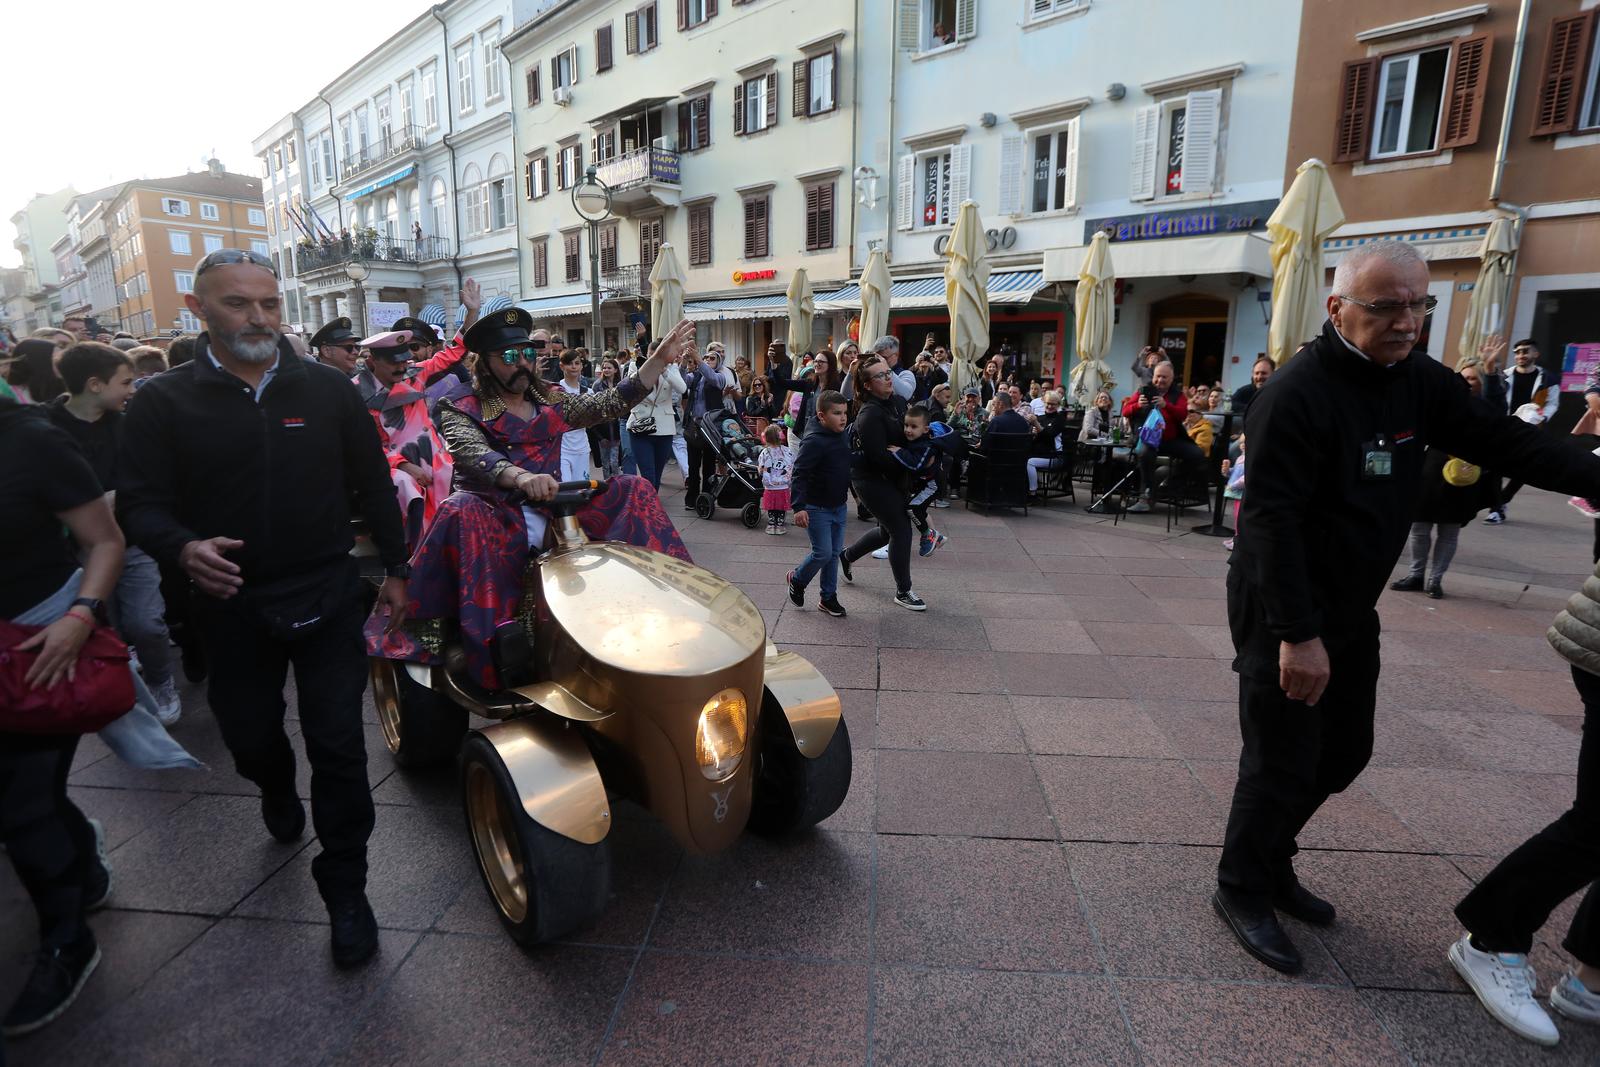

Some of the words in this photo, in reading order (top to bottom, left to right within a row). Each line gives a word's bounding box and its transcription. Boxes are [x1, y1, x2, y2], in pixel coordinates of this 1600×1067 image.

[1170, 115, 1186, 166] Swiss
[653, 154, 678, 165] HAPPY
[653, 163, 680, 174] HOSTEL
[926, 162, 938, 203] Swiss
[1101, 211, 1216, 240] Gentleman
[1226, 214, 1259, 230] bar
